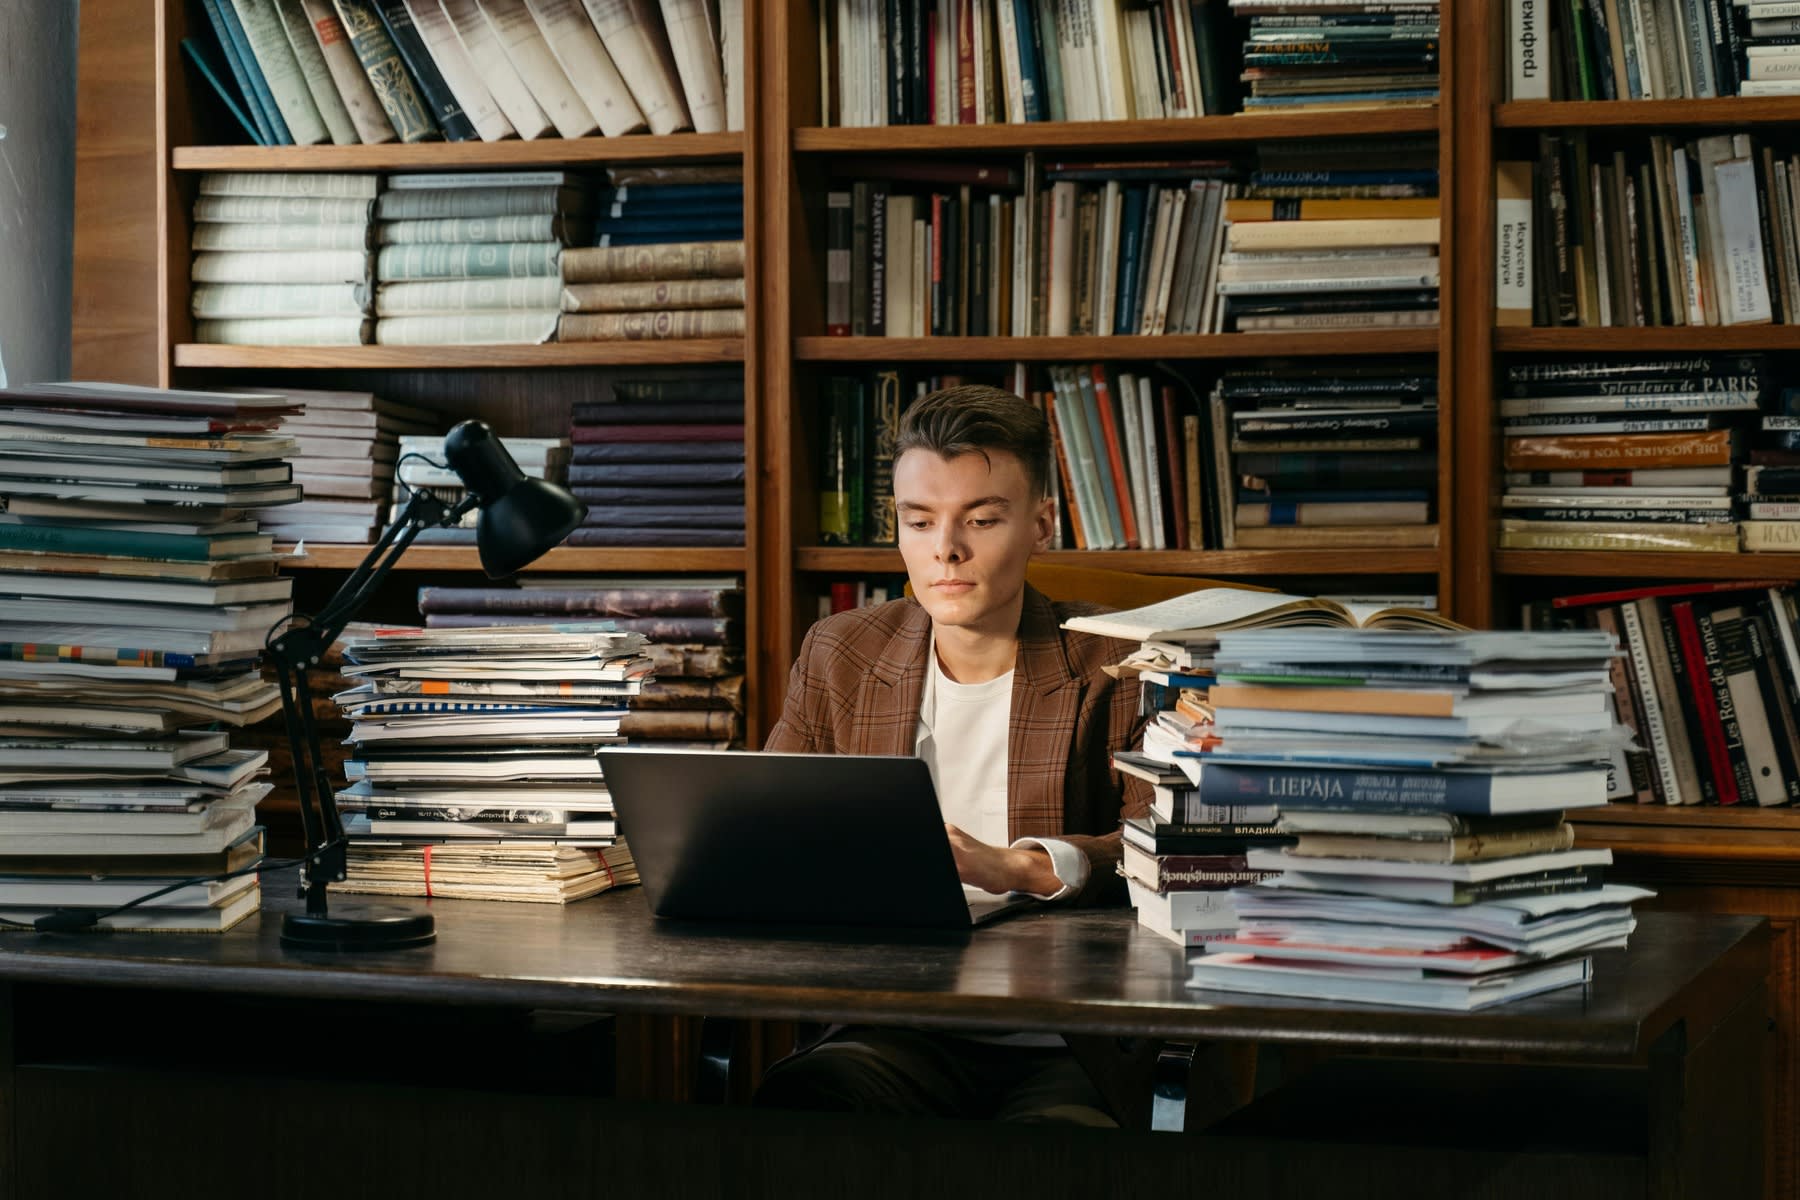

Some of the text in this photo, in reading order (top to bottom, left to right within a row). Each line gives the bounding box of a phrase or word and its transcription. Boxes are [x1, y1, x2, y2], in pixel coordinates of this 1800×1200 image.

[1520, 0, 1537, 78] графика
[1501, 223, 1514, 285] Беларуси
[1514, 221, 1527, 288] Искусство
[1600, 374, 1759, 396] Splendeurs de PARIS
[1594, 447, 1621, 458] VON
[1625, 443, 1695, 457] MOSAIKEN
[1696, 444, 1719, 457] DIE
[1625, 606, 1649, 685] PLAKATKUNST
[1698, 617, 1722, 666] France
[1709, 668, 1726, 685] de
[1643, 689, 1664, 747] LEIPZIGER
[1715, 689, 1737, 720] Rois
[1724, 722, 1744, 750] Les
[1268, 775, 1344, 801] LIEPĀJA
[1657, 756, 1676, 802] HORNIG
